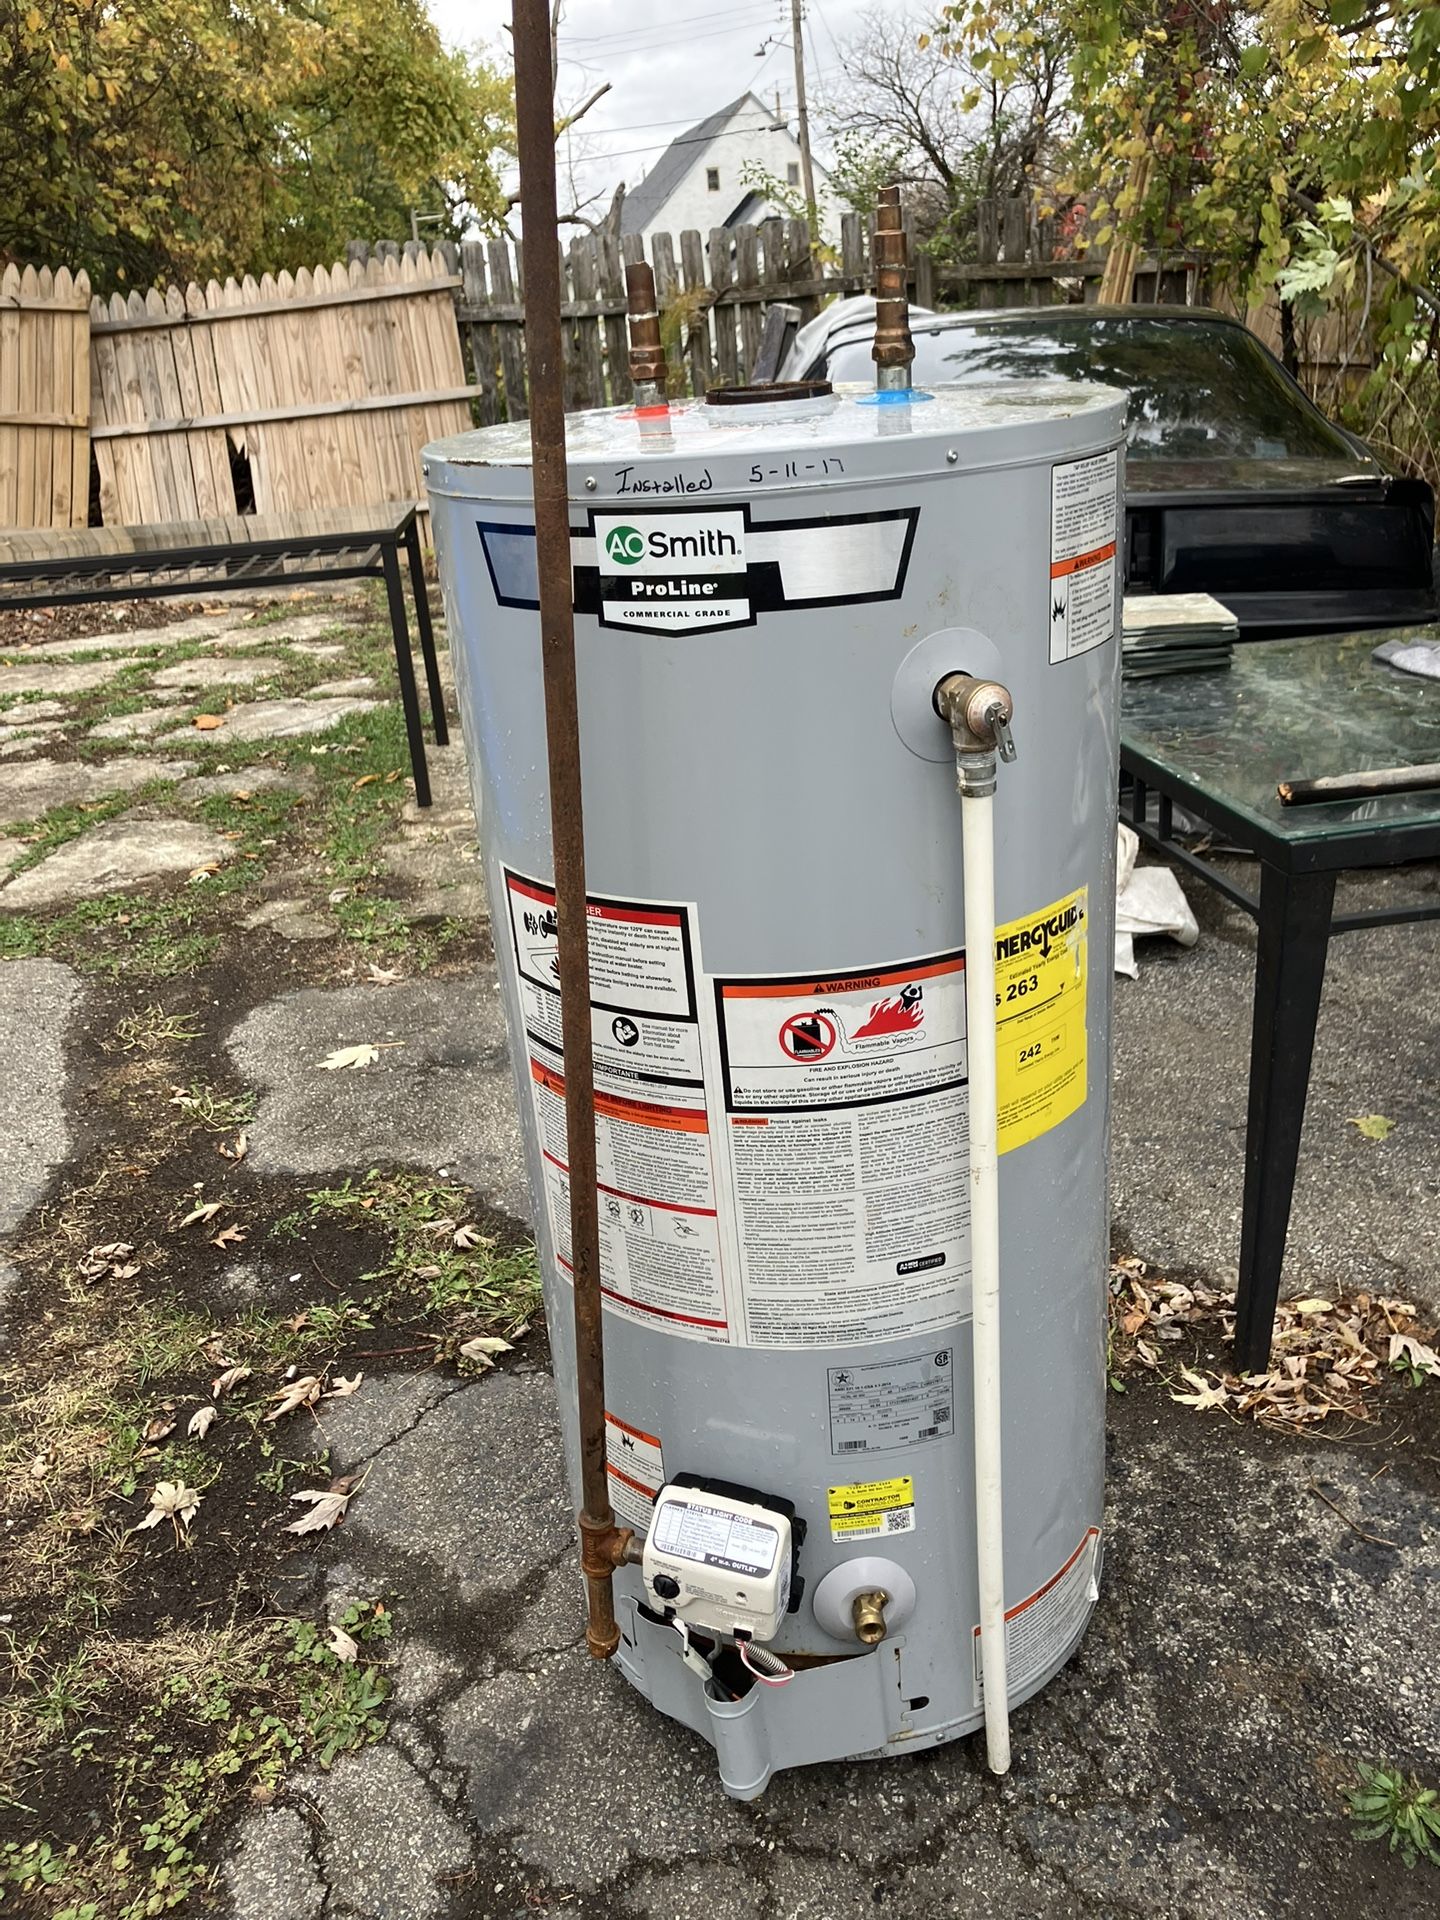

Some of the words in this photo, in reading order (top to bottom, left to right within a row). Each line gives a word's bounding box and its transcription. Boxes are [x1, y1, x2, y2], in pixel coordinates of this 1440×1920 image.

[615, 467, 712, 494] Installed
[748, 458, 845, 484] 5-11-17
[648, 529, 736, 558] Smith
[631, 579, 714, 596] ProLine
[623, 610, 690, 618] COMMERCIAL
[695, 609, 731, 617] GRADE
[592, 920, 618, 929] temperature
[608, 929, 627, 937] instantly
[632, 955, 647, 964] before
[826, 977, 881, 993] WARNING
[1006, 974, 1038, 1002] 263
[642, 1029, 666, 1037] information
[642, 1035, 666, 1043] preventing
[855, 1040, 890, 1050] Flammable
[891, 1036, 914, 1046] Vapors
[1019, 1043, 1041, 1063] 242
[837, 1062, 870, 1072] EXPLOSION
[871, 1058, 894, 1066] HAZARD
[796, 1085, 820, 1093] gasoline
[844, 1080, 873, 1089] flammable
[874, 1077, 892, 1086] vapors
[904, 1071, 922, 1079] liquids
[938, 1063, 956, 1073] vicinity
[861, 1069, 877, 1077] injury
[809, 1091, 830, 1099] Storage
[863, 1084, 887, 1092] gasoline
[909, 1075, 936, 1084] flammable
[937, 1071, 954, 1079] vapors
[844, 1092, 871, 1100] appliance
[905, 1082, 924, 1090] serious
[925, 1078, 940, 1087] injury
[918, 1256, 943, 1267] CERTIFIED
[856, 1493, 900, 1505] CONTRACTOR
[687, 1502, 712, 1514] STATUS
[713, 1509, 733, 1519] LIGHT
[734, 1515, 753, 1525] CODE
[732, 1562, 758, 1574] OUTLET
